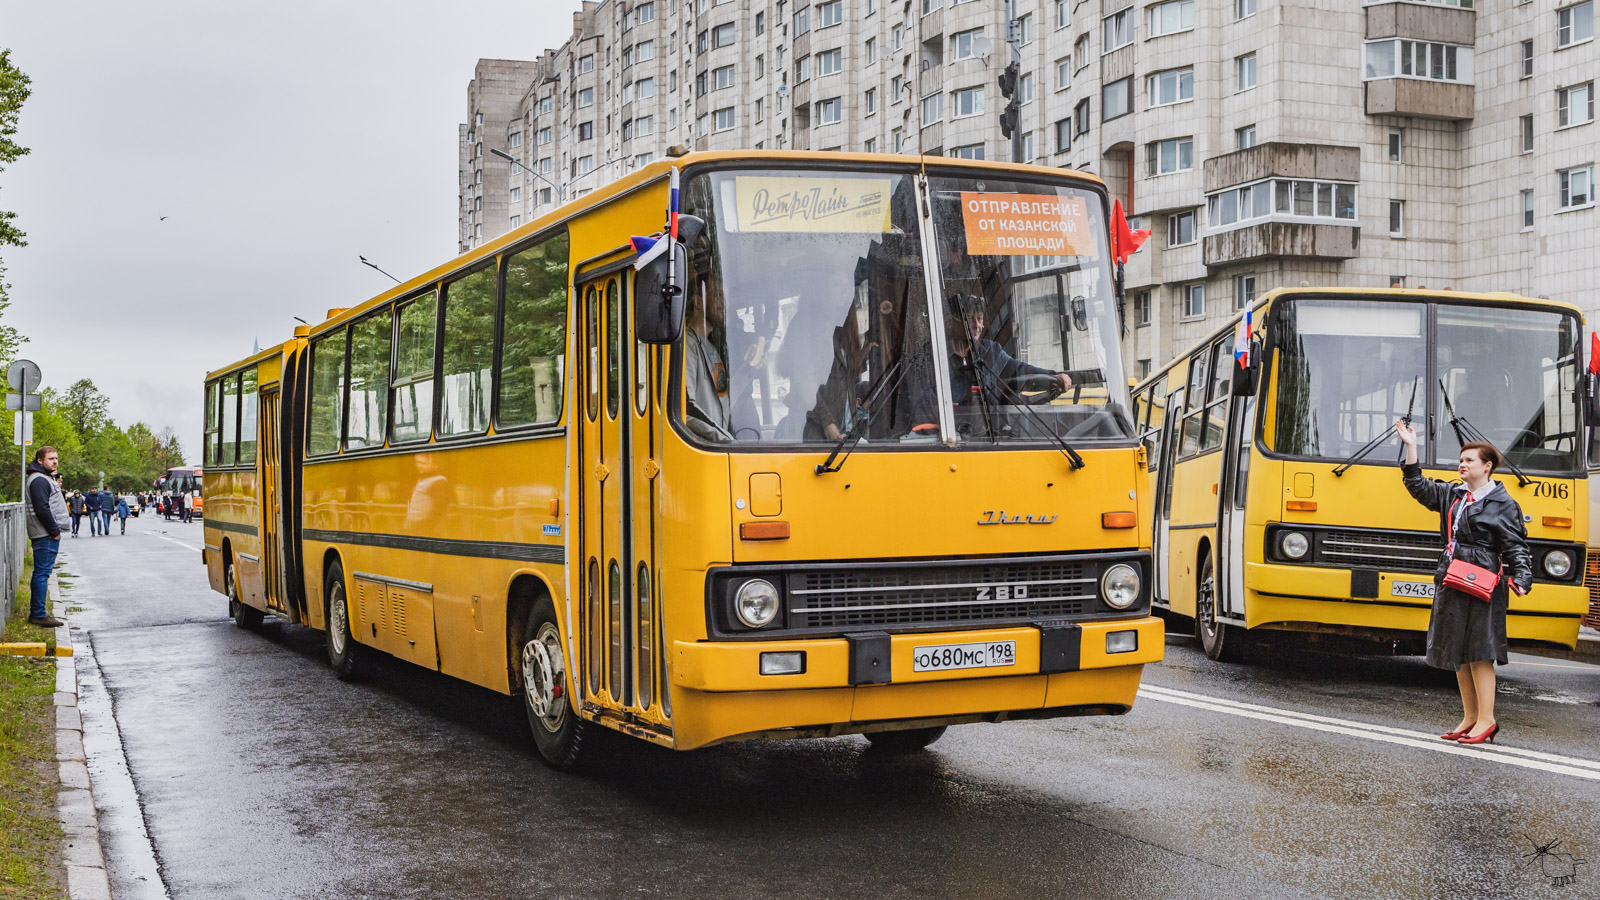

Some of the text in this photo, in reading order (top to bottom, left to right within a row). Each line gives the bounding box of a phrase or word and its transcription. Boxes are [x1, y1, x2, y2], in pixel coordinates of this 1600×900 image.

[968, 199, 1081, 217] ОТПРАВЛЕНИЕ
[978, 218, 1077, 233] ОТ КАЗАНСКОЙ
[997, 237, 1065, 251] ПЛОЩАДИ
[1531, 480, 1569, 500] 7016
[977, 510, 1059, 525] Ikarus
[988, 643, 1012, 659] 198
